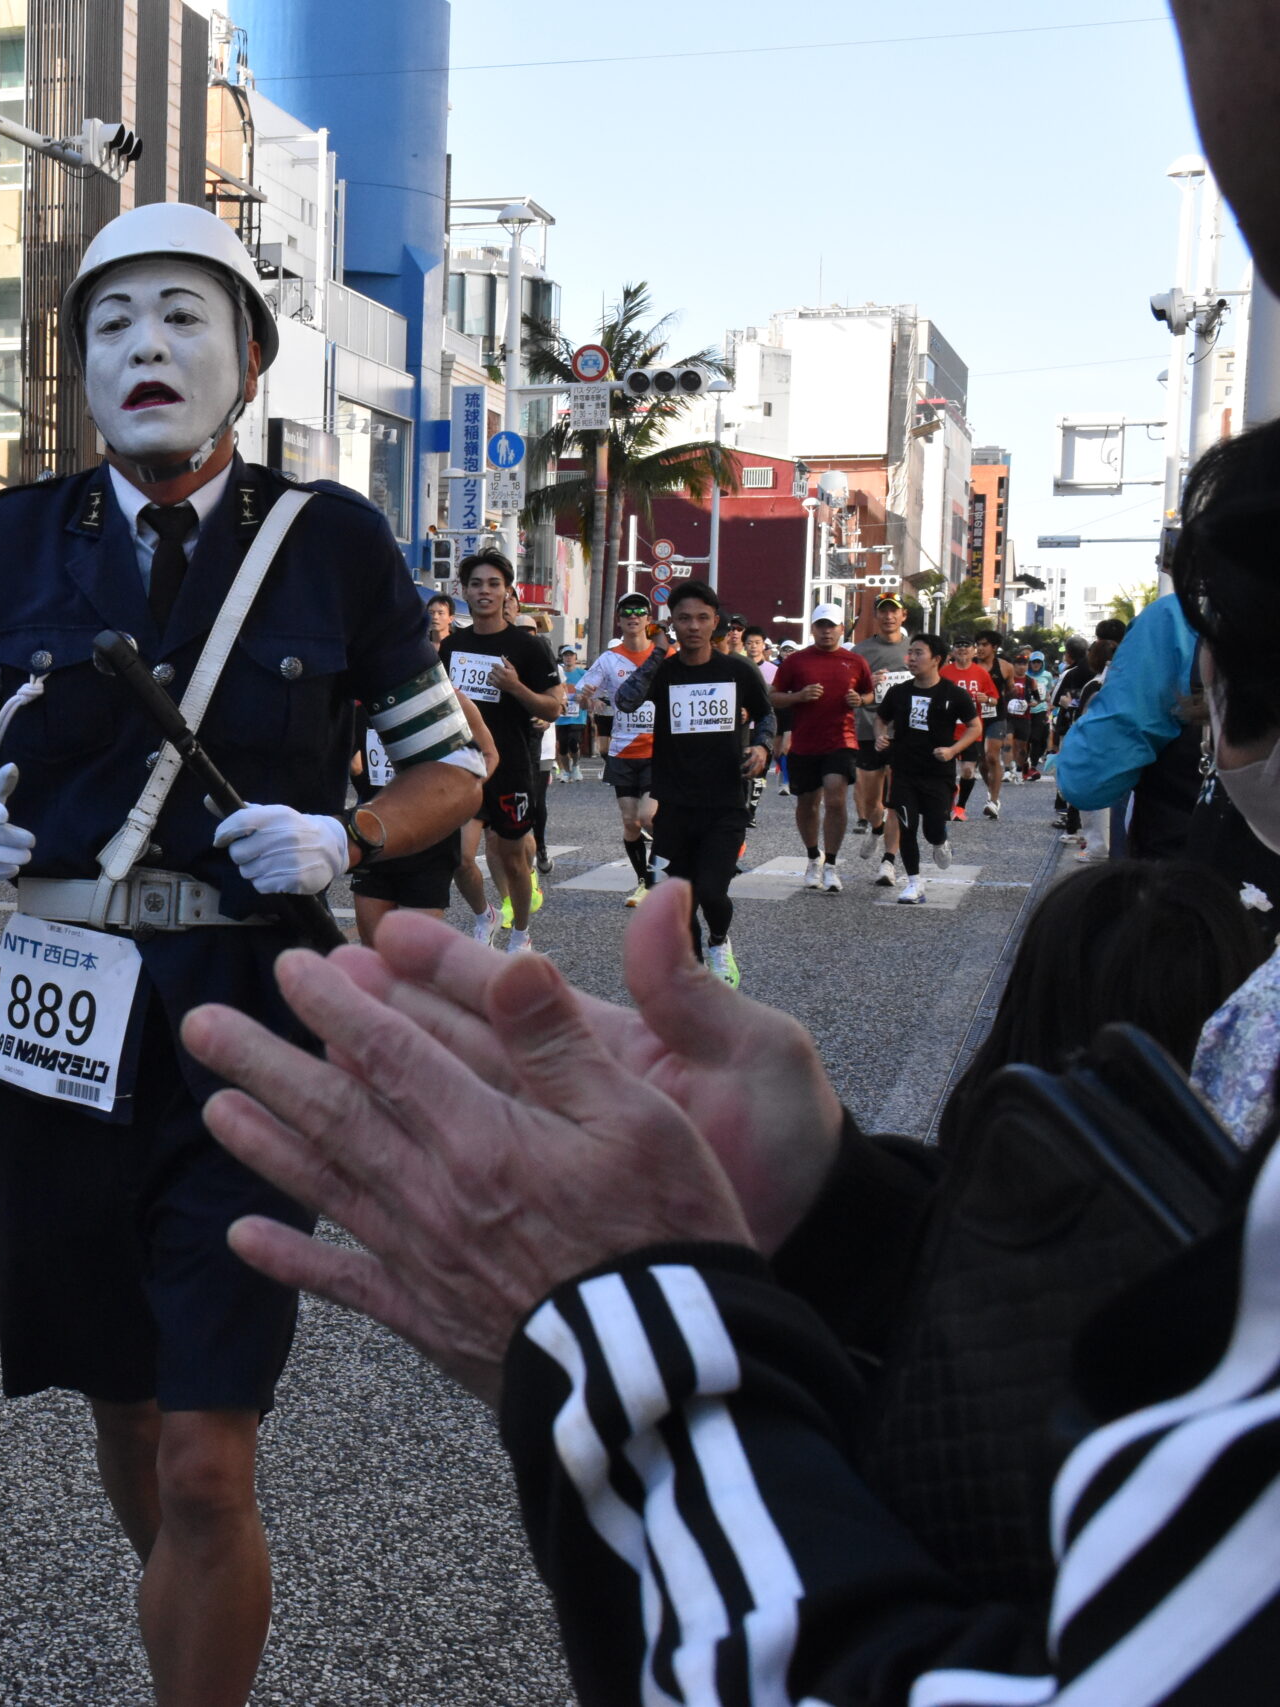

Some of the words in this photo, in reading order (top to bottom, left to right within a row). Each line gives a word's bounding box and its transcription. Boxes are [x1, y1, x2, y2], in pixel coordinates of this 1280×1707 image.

[460, 668, 491, 687] 139
[672, 702, 681, 718] C
[689, 700, 728, 718] 1368
[369, 749, 379, 767] C
